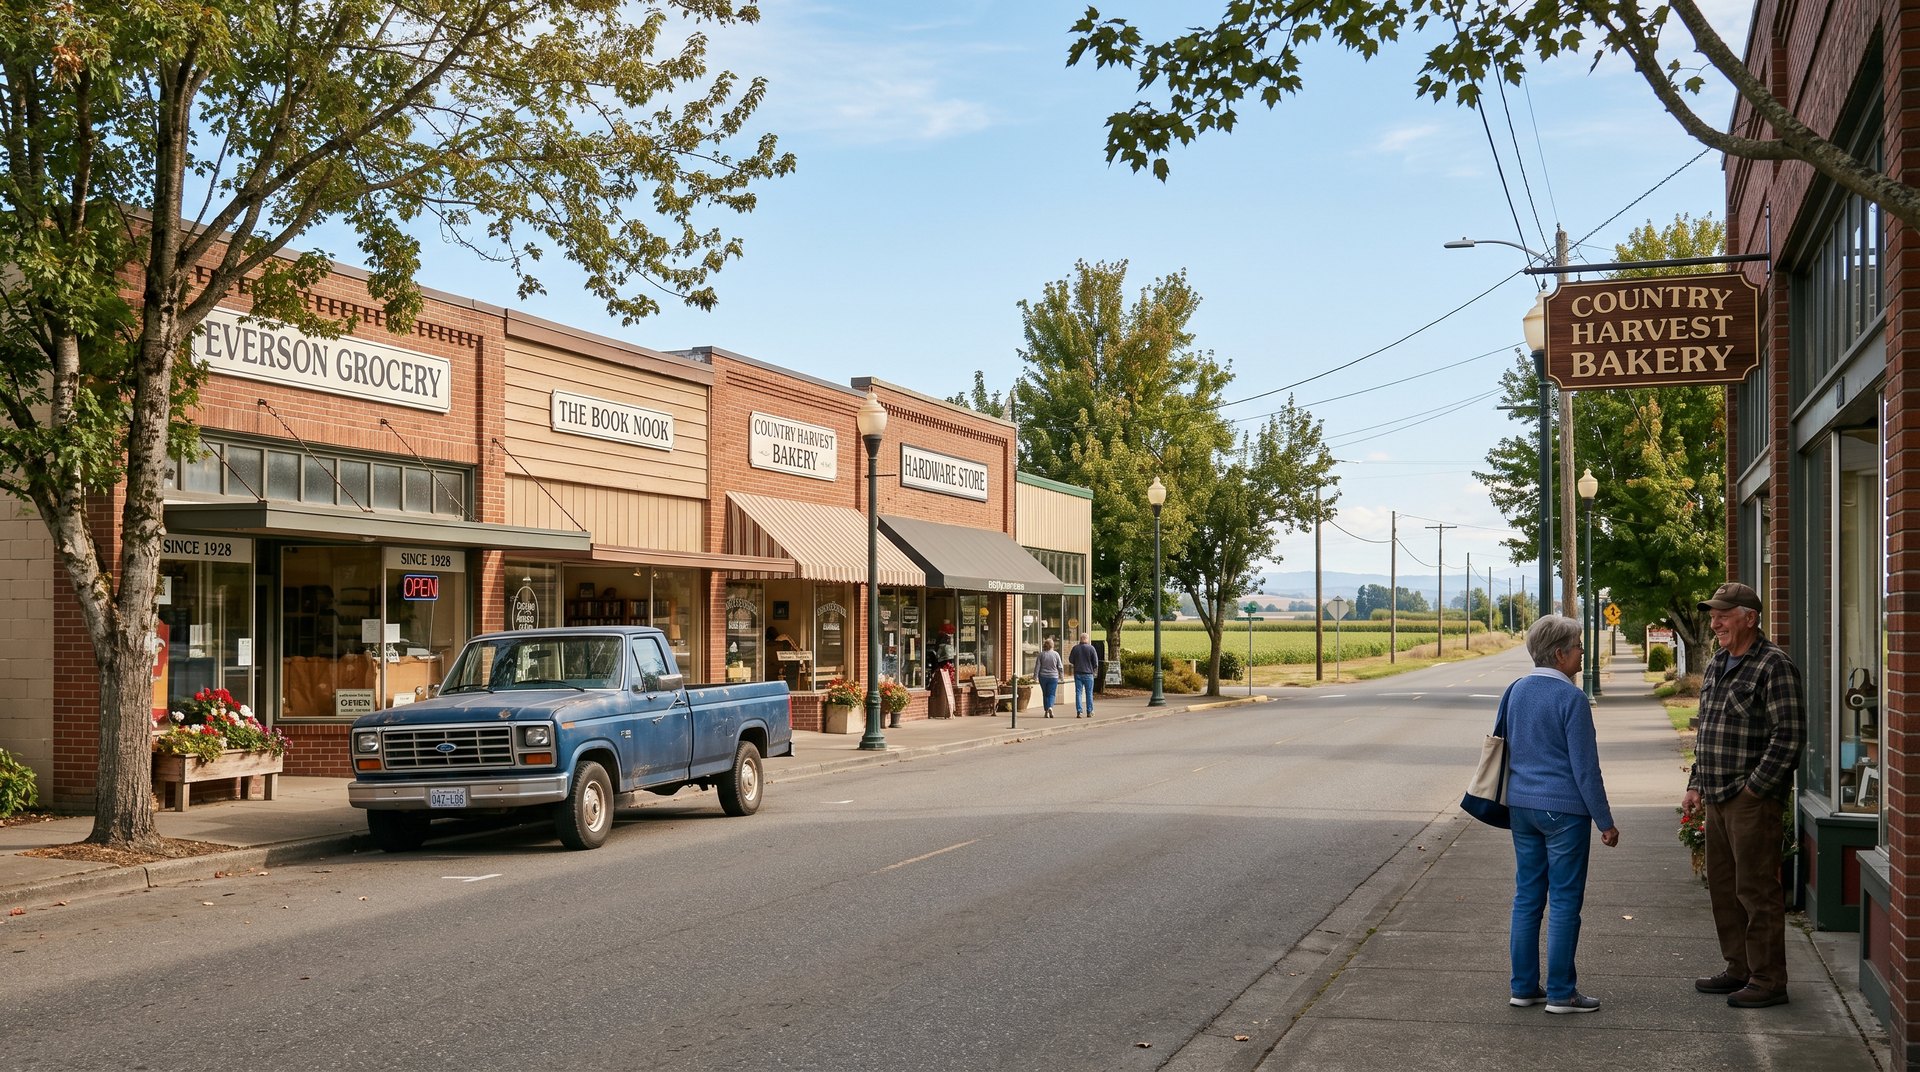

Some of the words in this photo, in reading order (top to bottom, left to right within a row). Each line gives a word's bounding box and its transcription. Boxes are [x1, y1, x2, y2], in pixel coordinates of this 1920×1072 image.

[1571, 286, 1733, 318] COUNTRY
[1571, 315, 1733, 345] HARVEST
[205, 320, 328, 378] EVERSON
[336, 348, 442, 398] GROCERY
[1571, 345, 1734, 378] BAKERY
[559, 400, 587, 426] THE
[591, 406, 630, 433] BOOK
[633, 414, 669, 441] NOOK
[754, 419, 796, 442] COUNTRY
[797, 428, 835, 451] HARVEST
[772, 443, 818, 471] BAKERY
[904, 454, 957, 486] HARDWARE
[958, 467, 985, 491] STORE
[163, 539, 200, 555] SINCE
[204, 541, 232, 556] 1928
[400, 552, 428, 566] SINCE
[430, 554, 451, 567] 1928
[404, 577, 438, 598] OPEN
